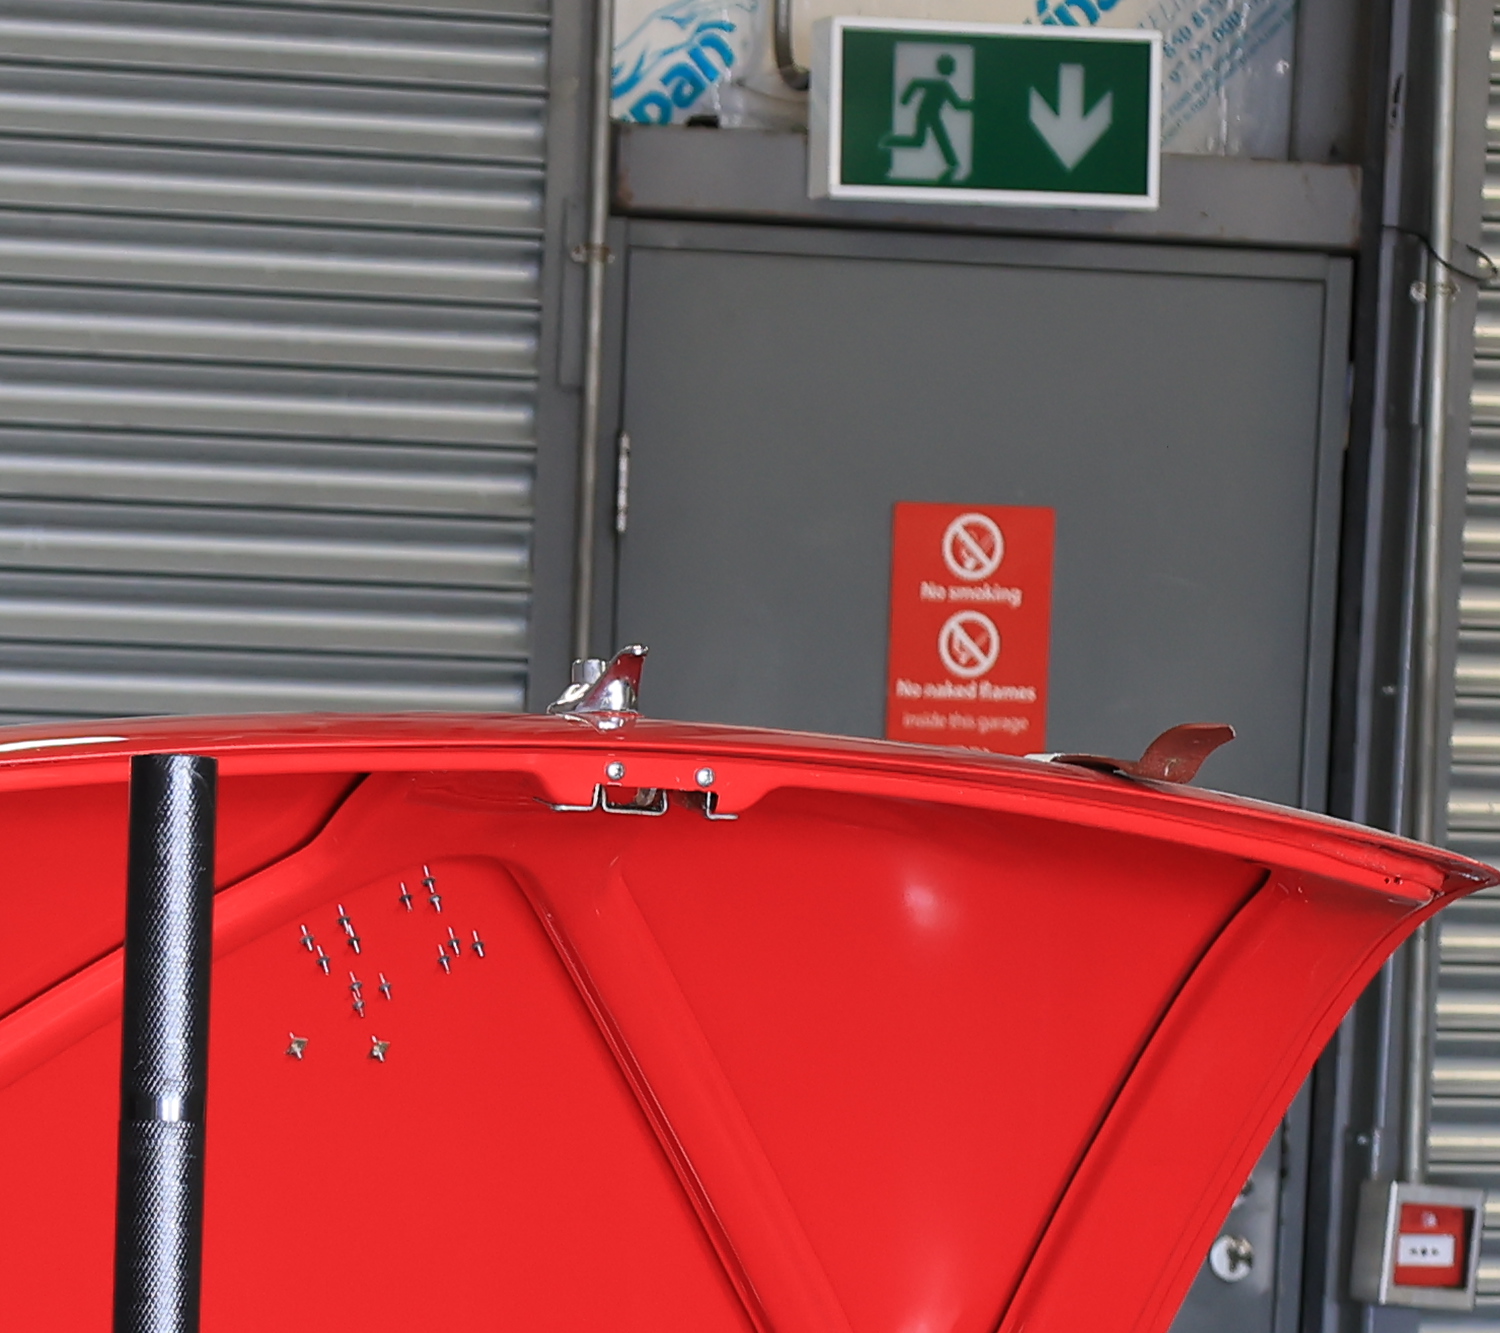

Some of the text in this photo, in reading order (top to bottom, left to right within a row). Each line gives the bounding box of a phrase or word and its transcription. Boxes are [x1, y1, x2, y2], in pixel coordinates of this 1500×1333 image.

[920, 581, 1023, 609] No smoking
[896, 679, 1037, 702] No naked flames
